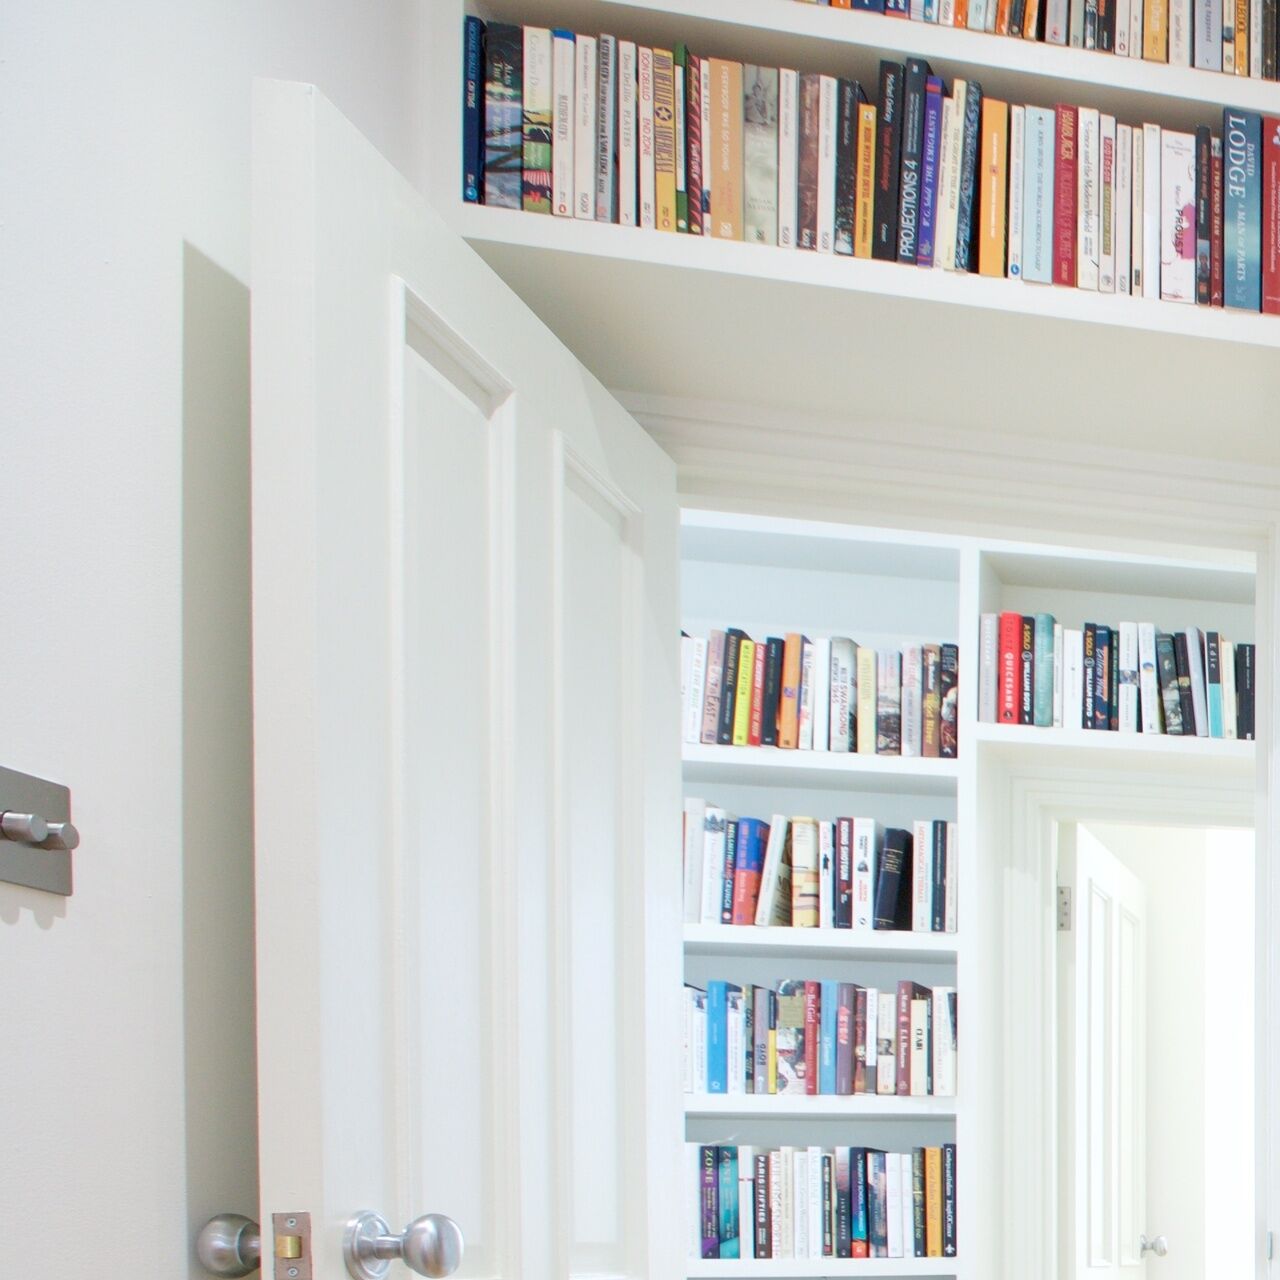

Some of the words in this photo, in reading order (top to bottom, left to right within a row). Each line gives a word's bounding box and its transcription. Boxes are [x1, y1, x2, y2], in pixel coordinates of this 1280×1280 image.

[904, 160, 916, 169] 4
[1229, 115, 1246, 198] LODGE
[1247, 143, 1255, 176] DAVID
[900, 172, 917, 256] PROJECTIONS
[1175, 209, 1183, 255] PROUST
[1209, 643, 1217, 669] Edie
[1004, 652, 1014, 709] QUICKSAND
